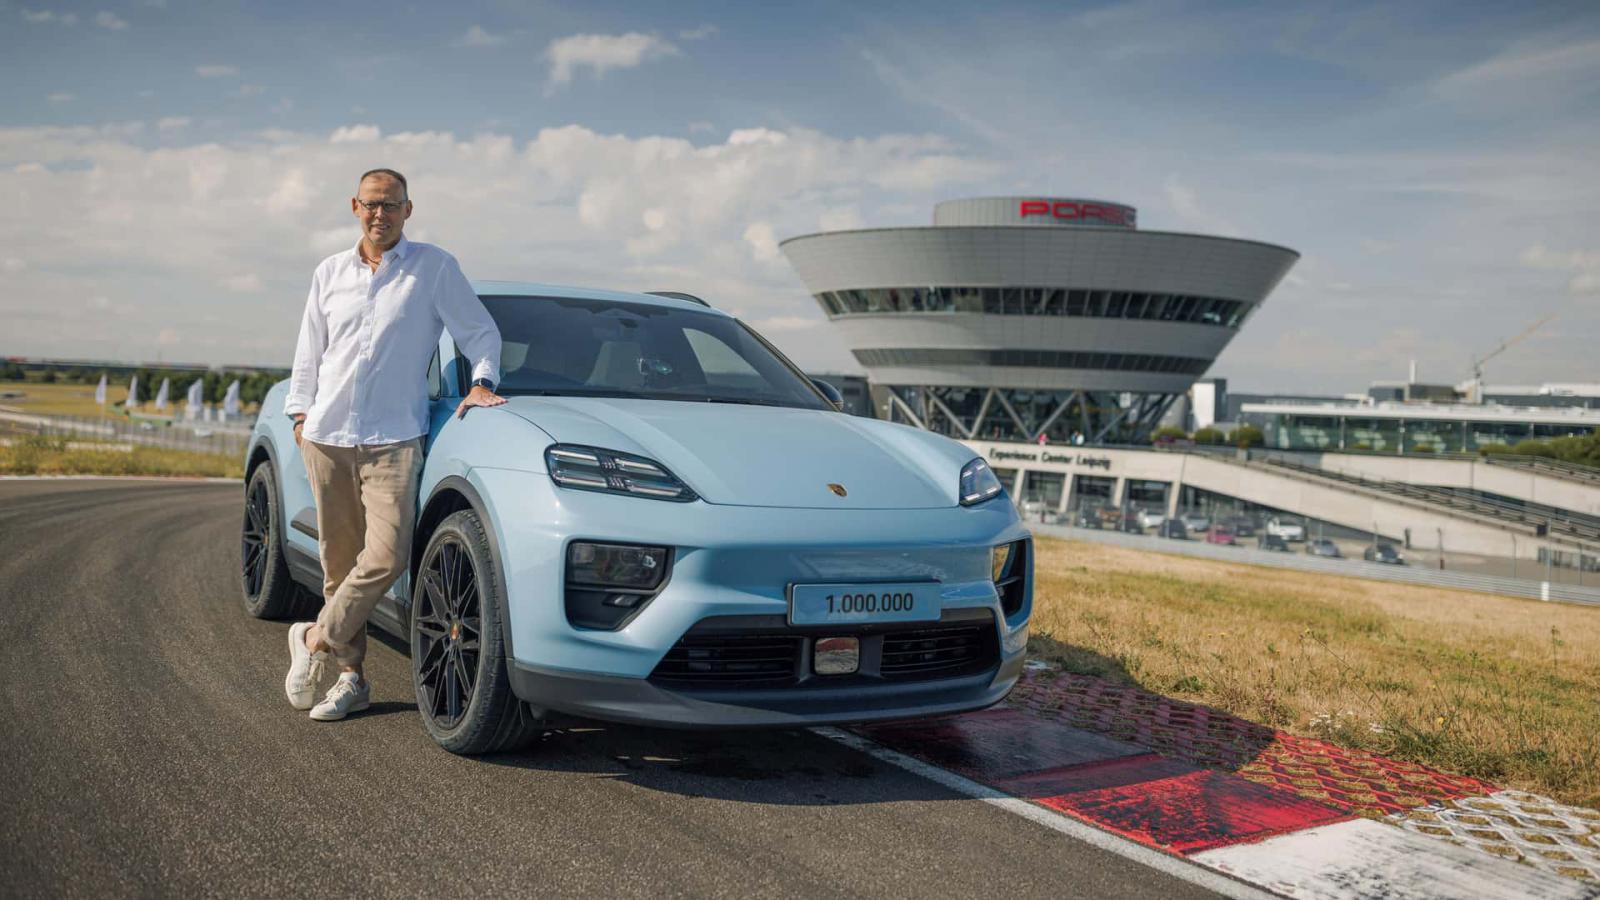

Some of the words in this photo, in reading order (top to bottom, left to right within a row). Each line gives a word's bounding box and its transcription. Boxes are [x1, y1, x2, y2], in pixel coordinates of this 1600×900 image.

[989, 448, 1037, 462] Experience
[1041, 451, 1072, 464] Center
[1077, 454, 1111, 471] Leipzig
[826, 592, 914, 614] 1.000.000
